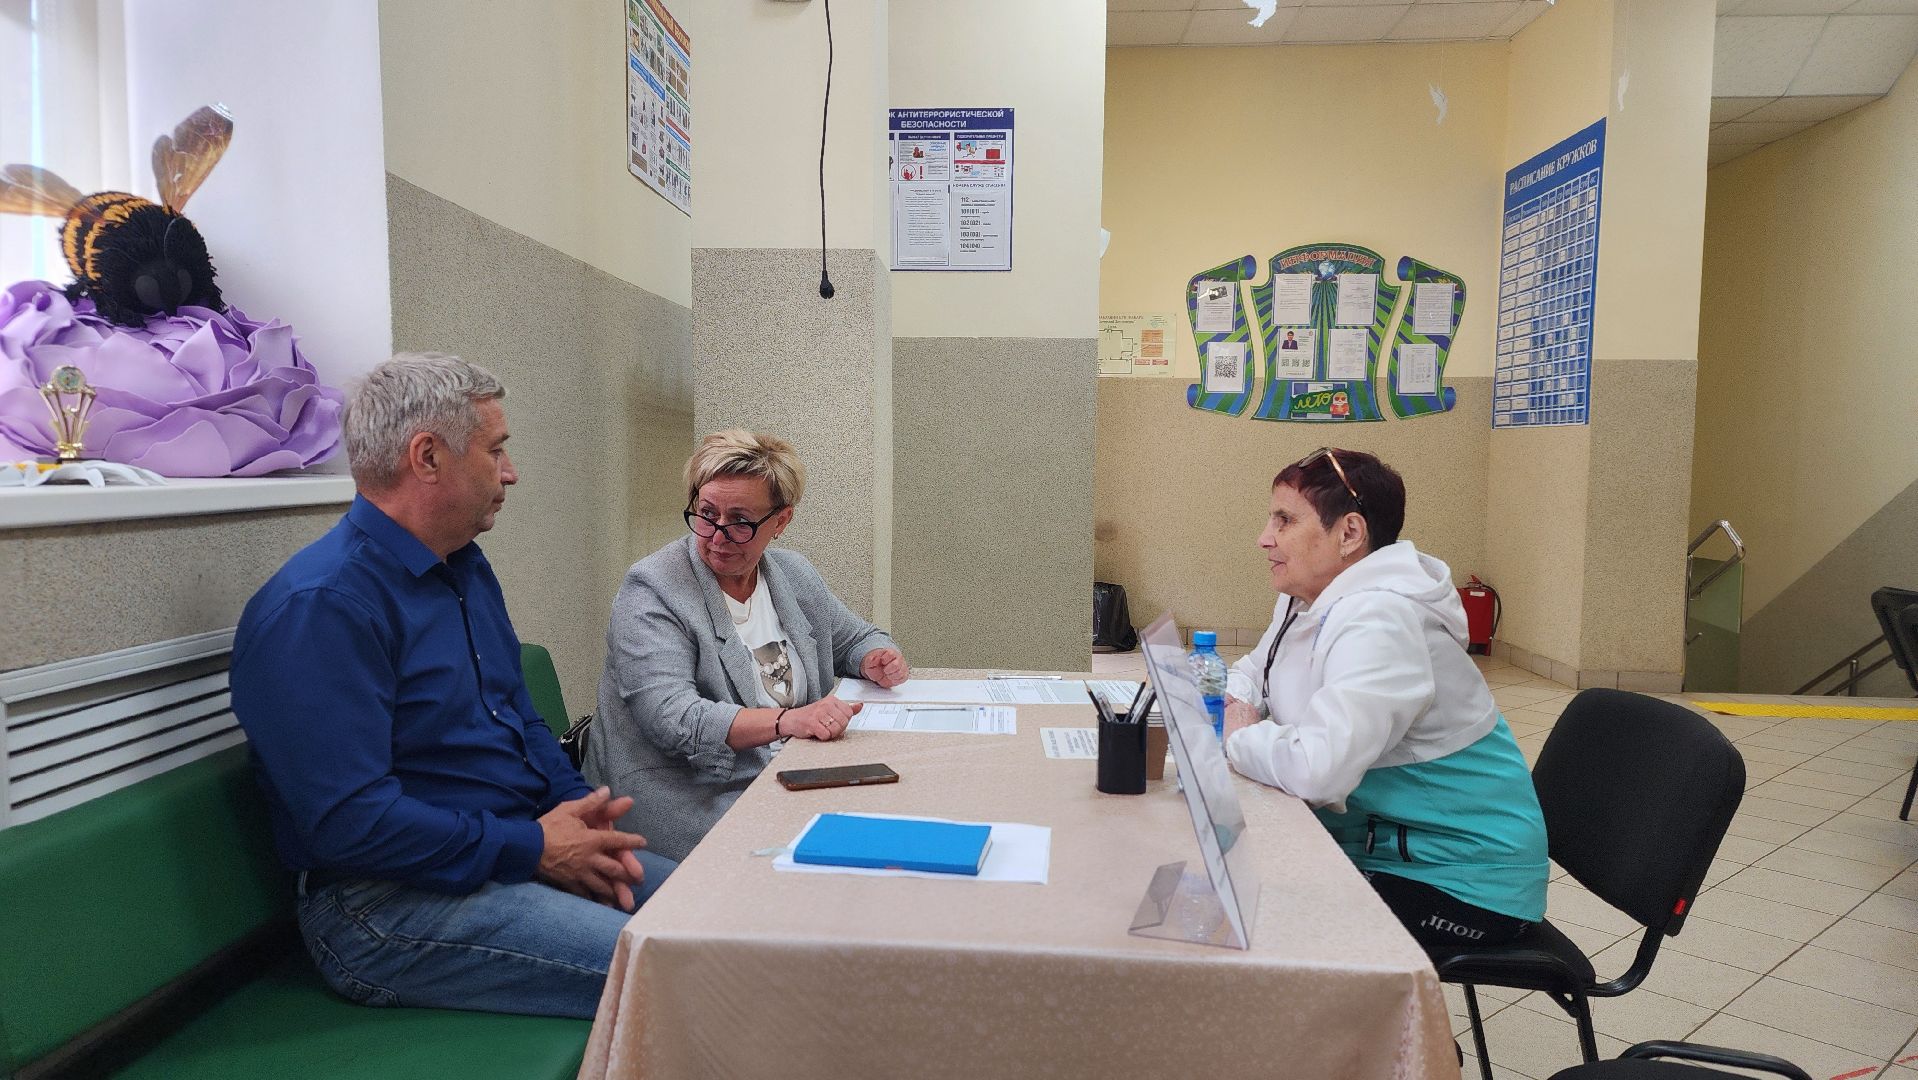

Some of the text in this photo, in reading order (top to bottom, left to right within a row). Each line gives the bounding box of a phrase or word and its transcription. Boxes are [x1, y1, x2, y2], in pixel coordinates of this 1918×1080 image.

[898, 109, 1004, 118] АНТИТЕРРОРИСТИЧЕСКОЙ
[901, 120, 967, 128] БЕЗОПАСНОСТИ
[1510, 161, 1556, 195] РАСПИСАНИЕ
[1556, 139, 1598, 172] КРУЖКОВ
[1279, 250, 1376, 269] ИНФОРМАЦИЯ
